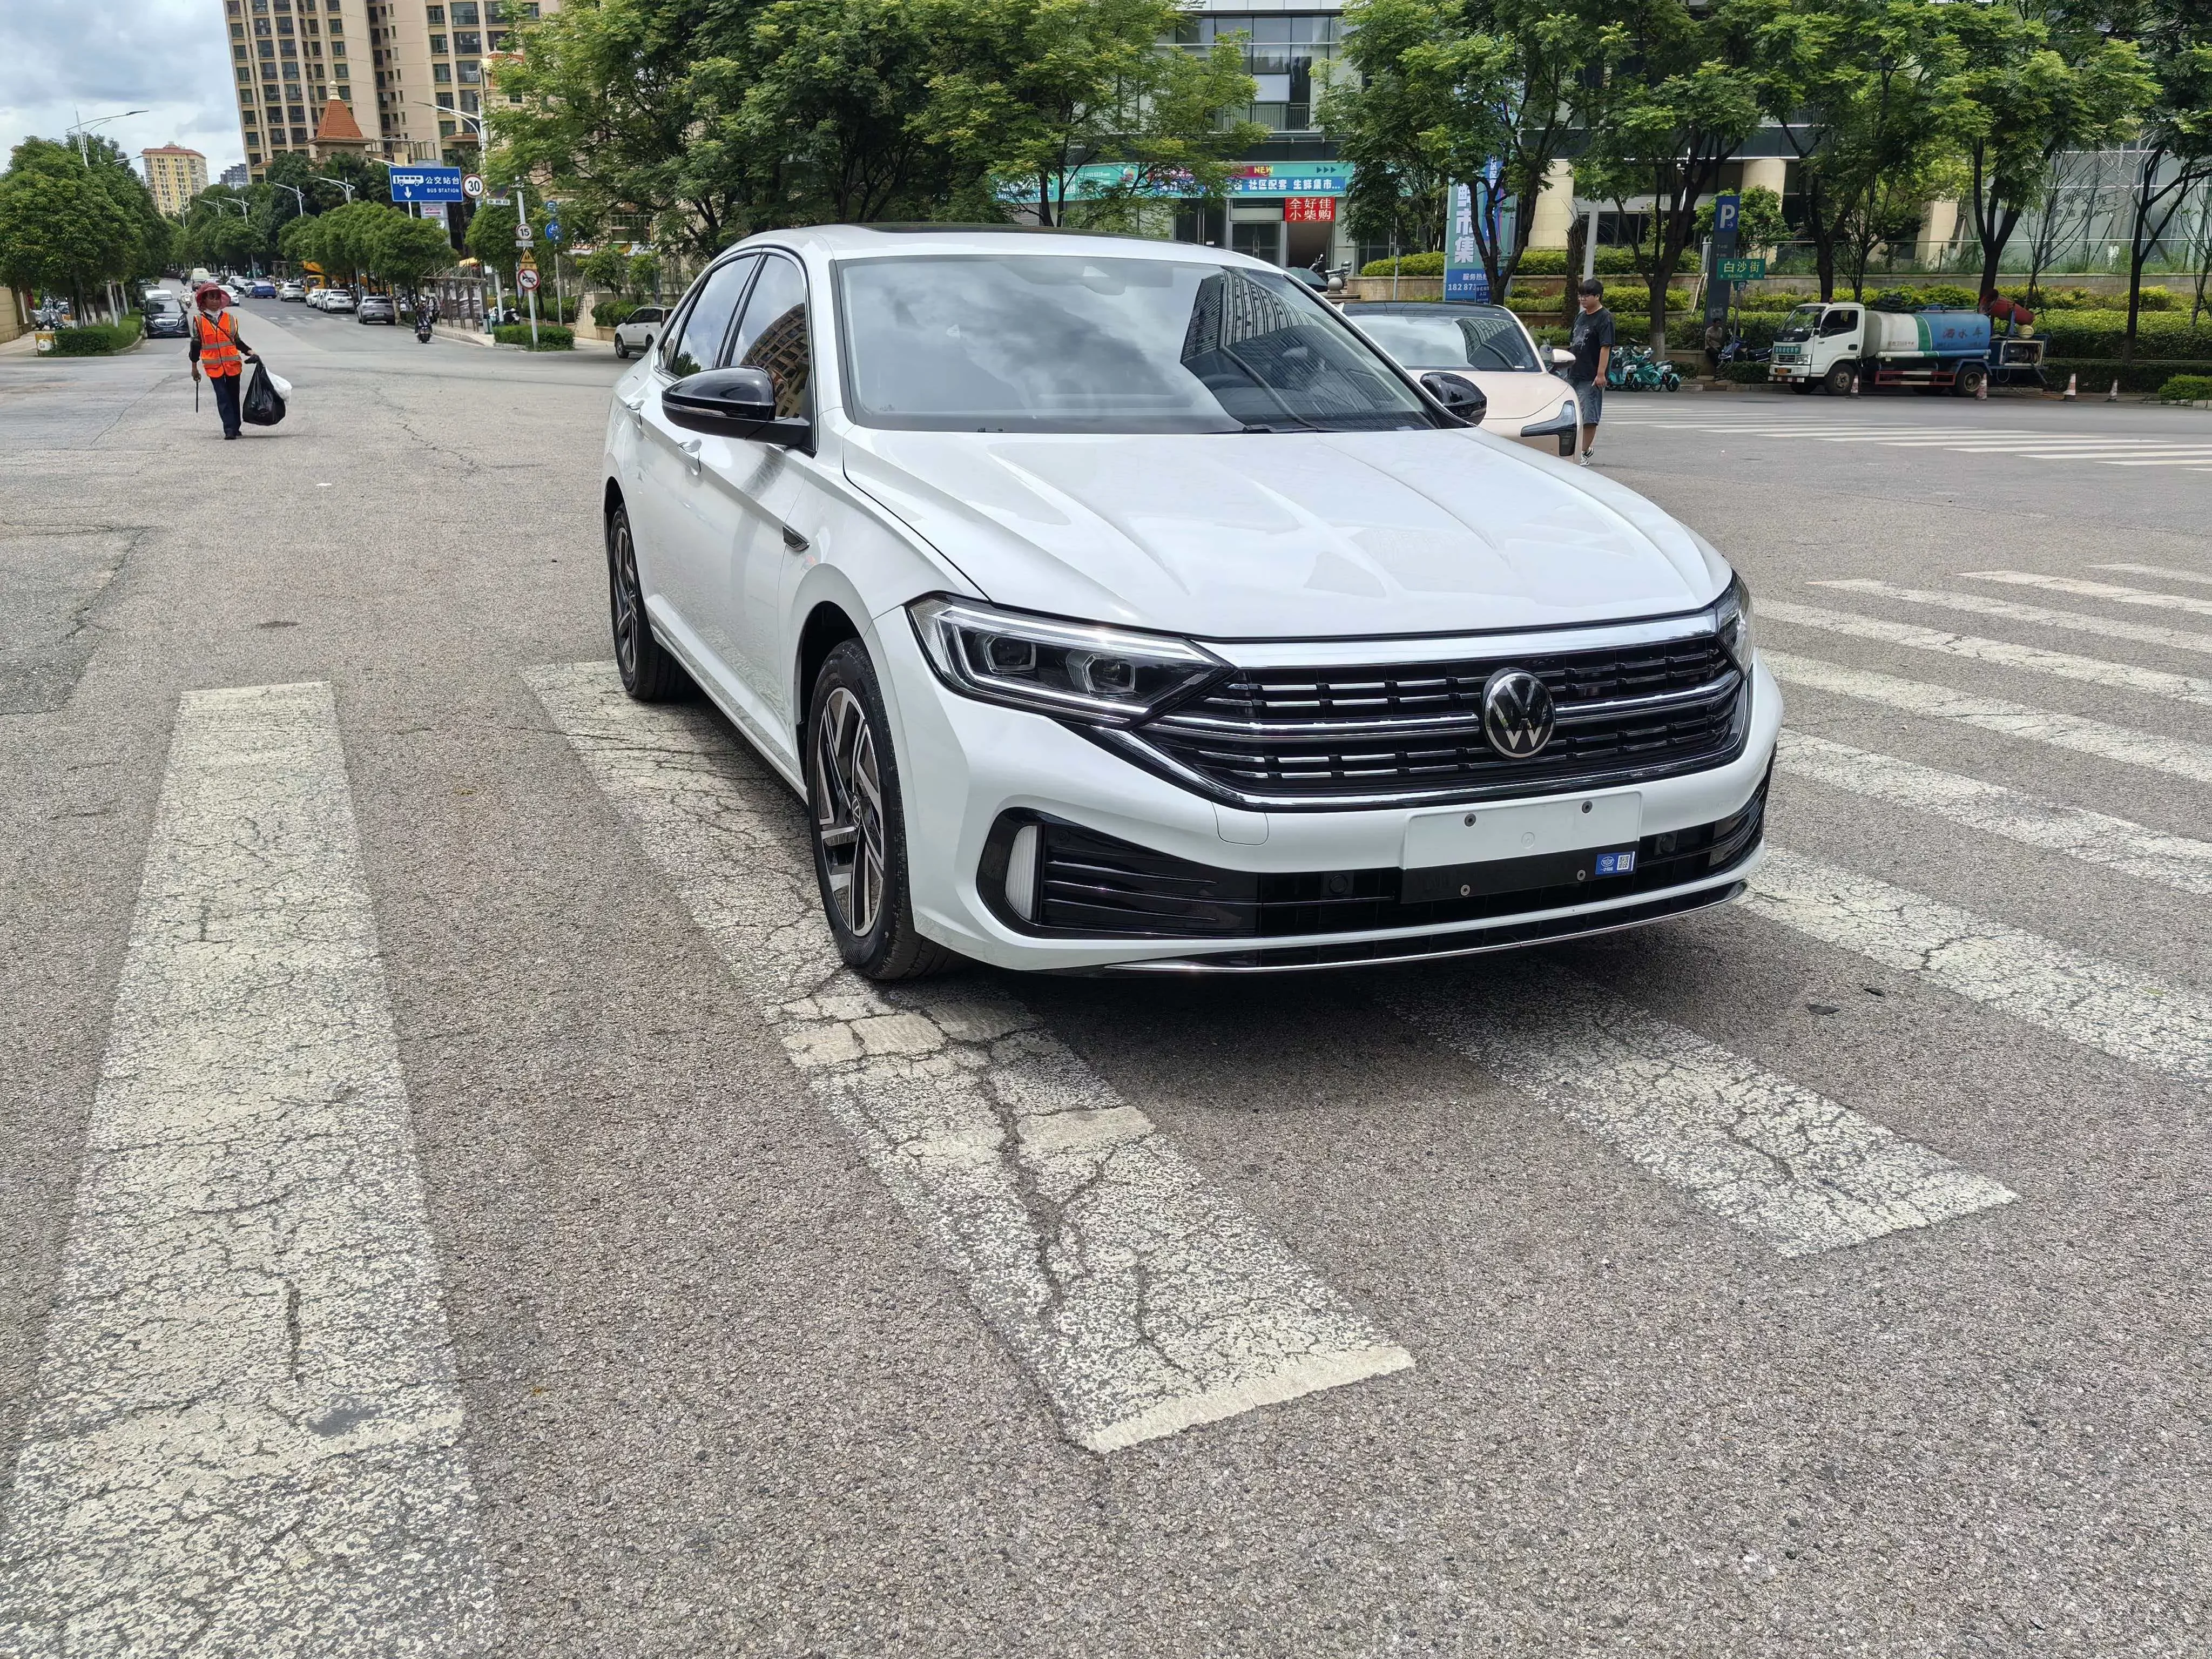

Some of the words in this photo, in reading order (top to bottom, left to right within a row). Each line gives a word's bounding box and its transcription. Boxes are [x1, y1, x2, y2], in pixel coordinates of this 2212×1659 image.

[425, 177, 459, 185] 公交站台
[468, 180, 480, 192] 30
[1289, 198, 1332, 209] 全好佳
[1289, 210, 1332, 220] 小柴购
[1719, 204, 1735, 229] P
[519, 228, 530, 237] 15
[1723, 261, 1761, 273] 白沙街
